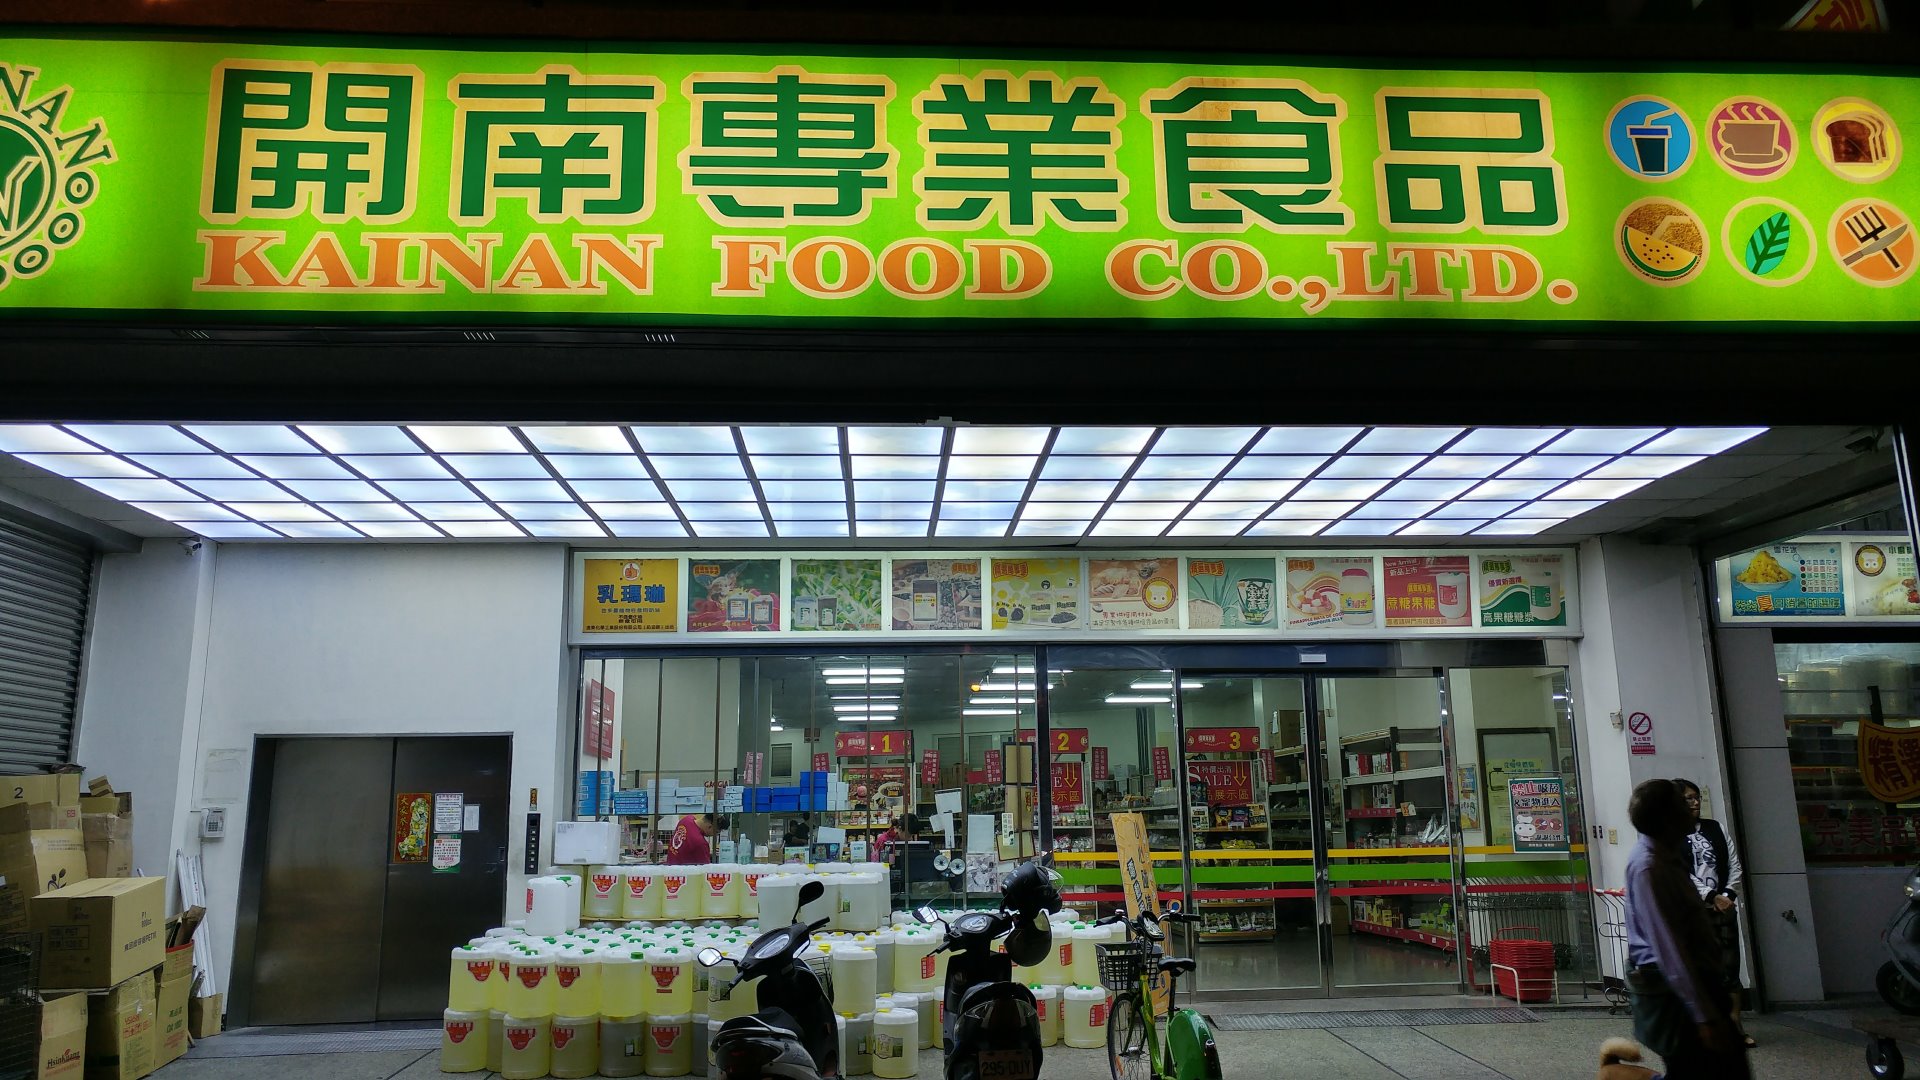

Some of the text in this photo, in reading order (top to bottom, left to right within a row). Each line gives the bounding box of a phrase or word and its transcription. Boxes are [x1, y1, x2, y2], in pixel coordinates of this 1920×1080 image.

[208, 64, 1563, 229] 開南專業食品
[197, 233, 662, 292] KAINAN
[715, 239, 1050, 298] FOOD
[881, 734, 893, 753] 1
[1057, 732, 1070, 751] 2
[1229, 731, 1241, 750] 3
[1188, 766, 1232, 786] SALE
[14, 787, 24, 799] 2
